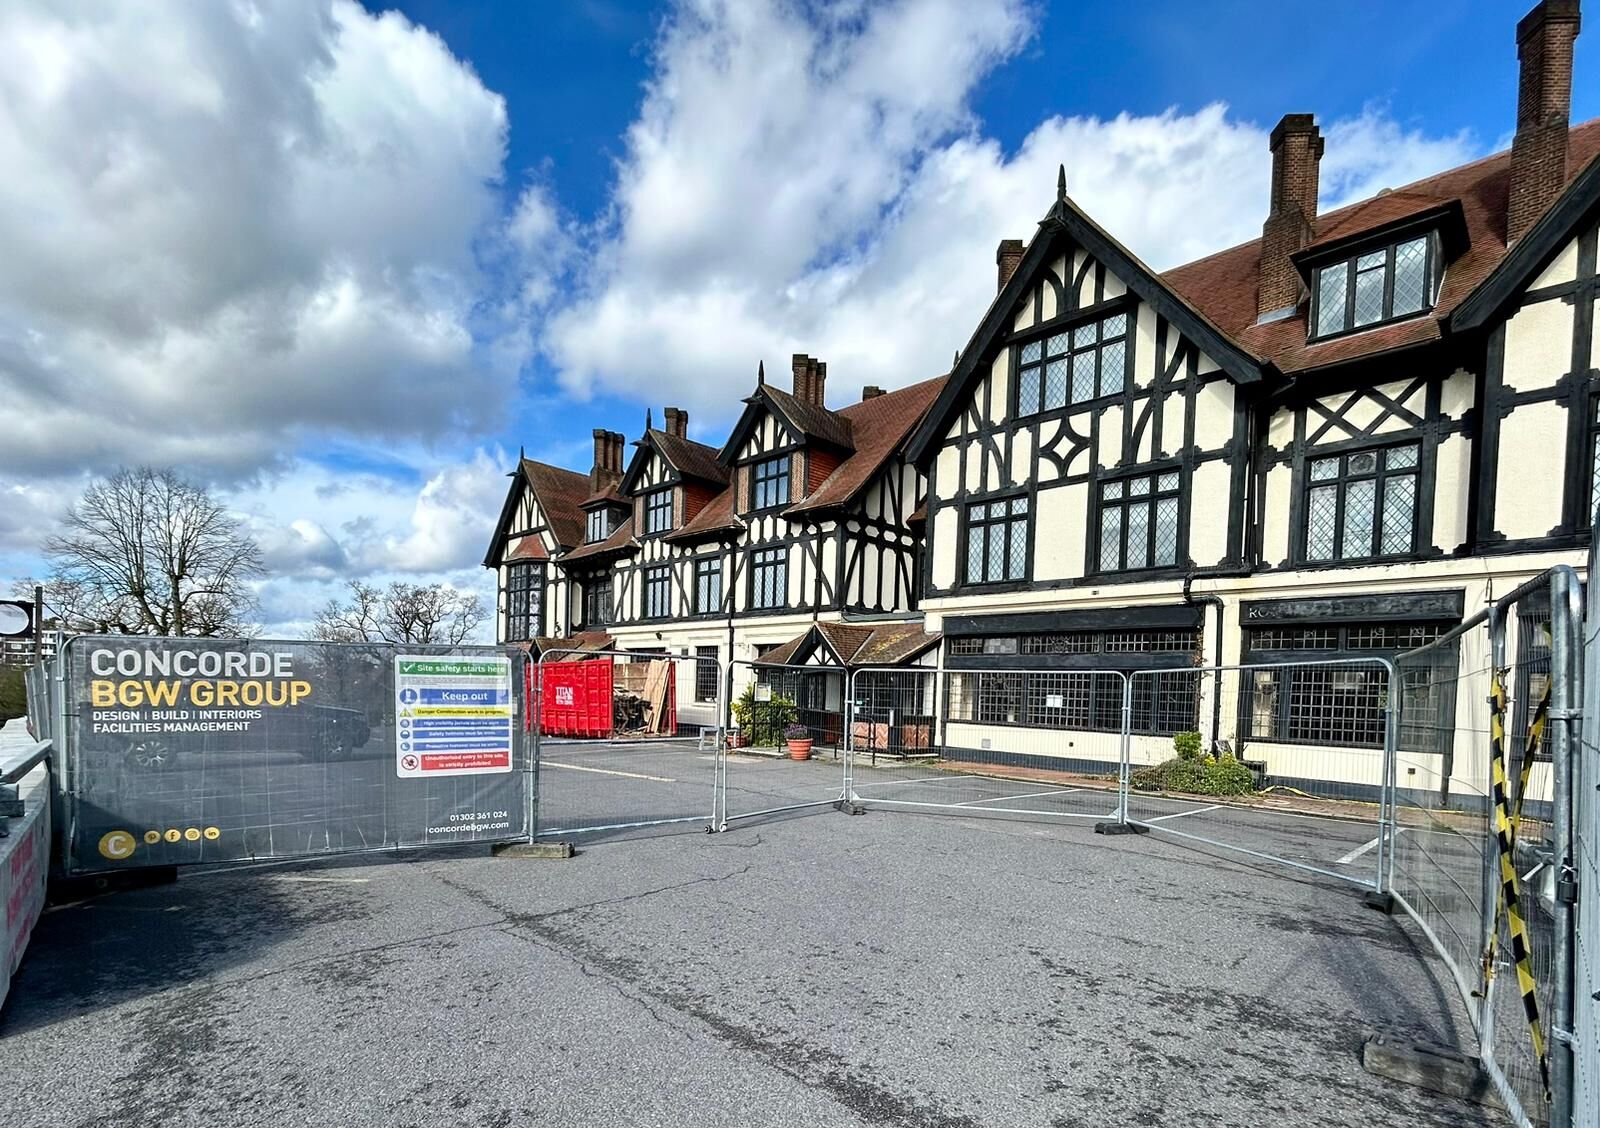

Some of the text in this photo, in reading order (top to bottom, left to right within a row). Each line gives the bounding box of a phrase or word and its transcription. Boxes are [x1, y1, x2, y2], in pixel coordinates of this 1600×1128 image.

[91, 649, 293, 677] CONCORDE
[417, 664, 434, 672] Site
[435, 665, 463, 674] safety
[487, 665, 505, 673] here
[91, 679, 312, 707] BGW GROUP
[442, 692, 488, 701] Keep out
[93, 709, 262, 721] DESIGN BUILD INTERIORS
[93, 721, 250, 733] FACILITIES MANAGEMENT
[449, 811, 508, 822] 01302 361 024
[428, 822, 509, 833] concordebgw.com
